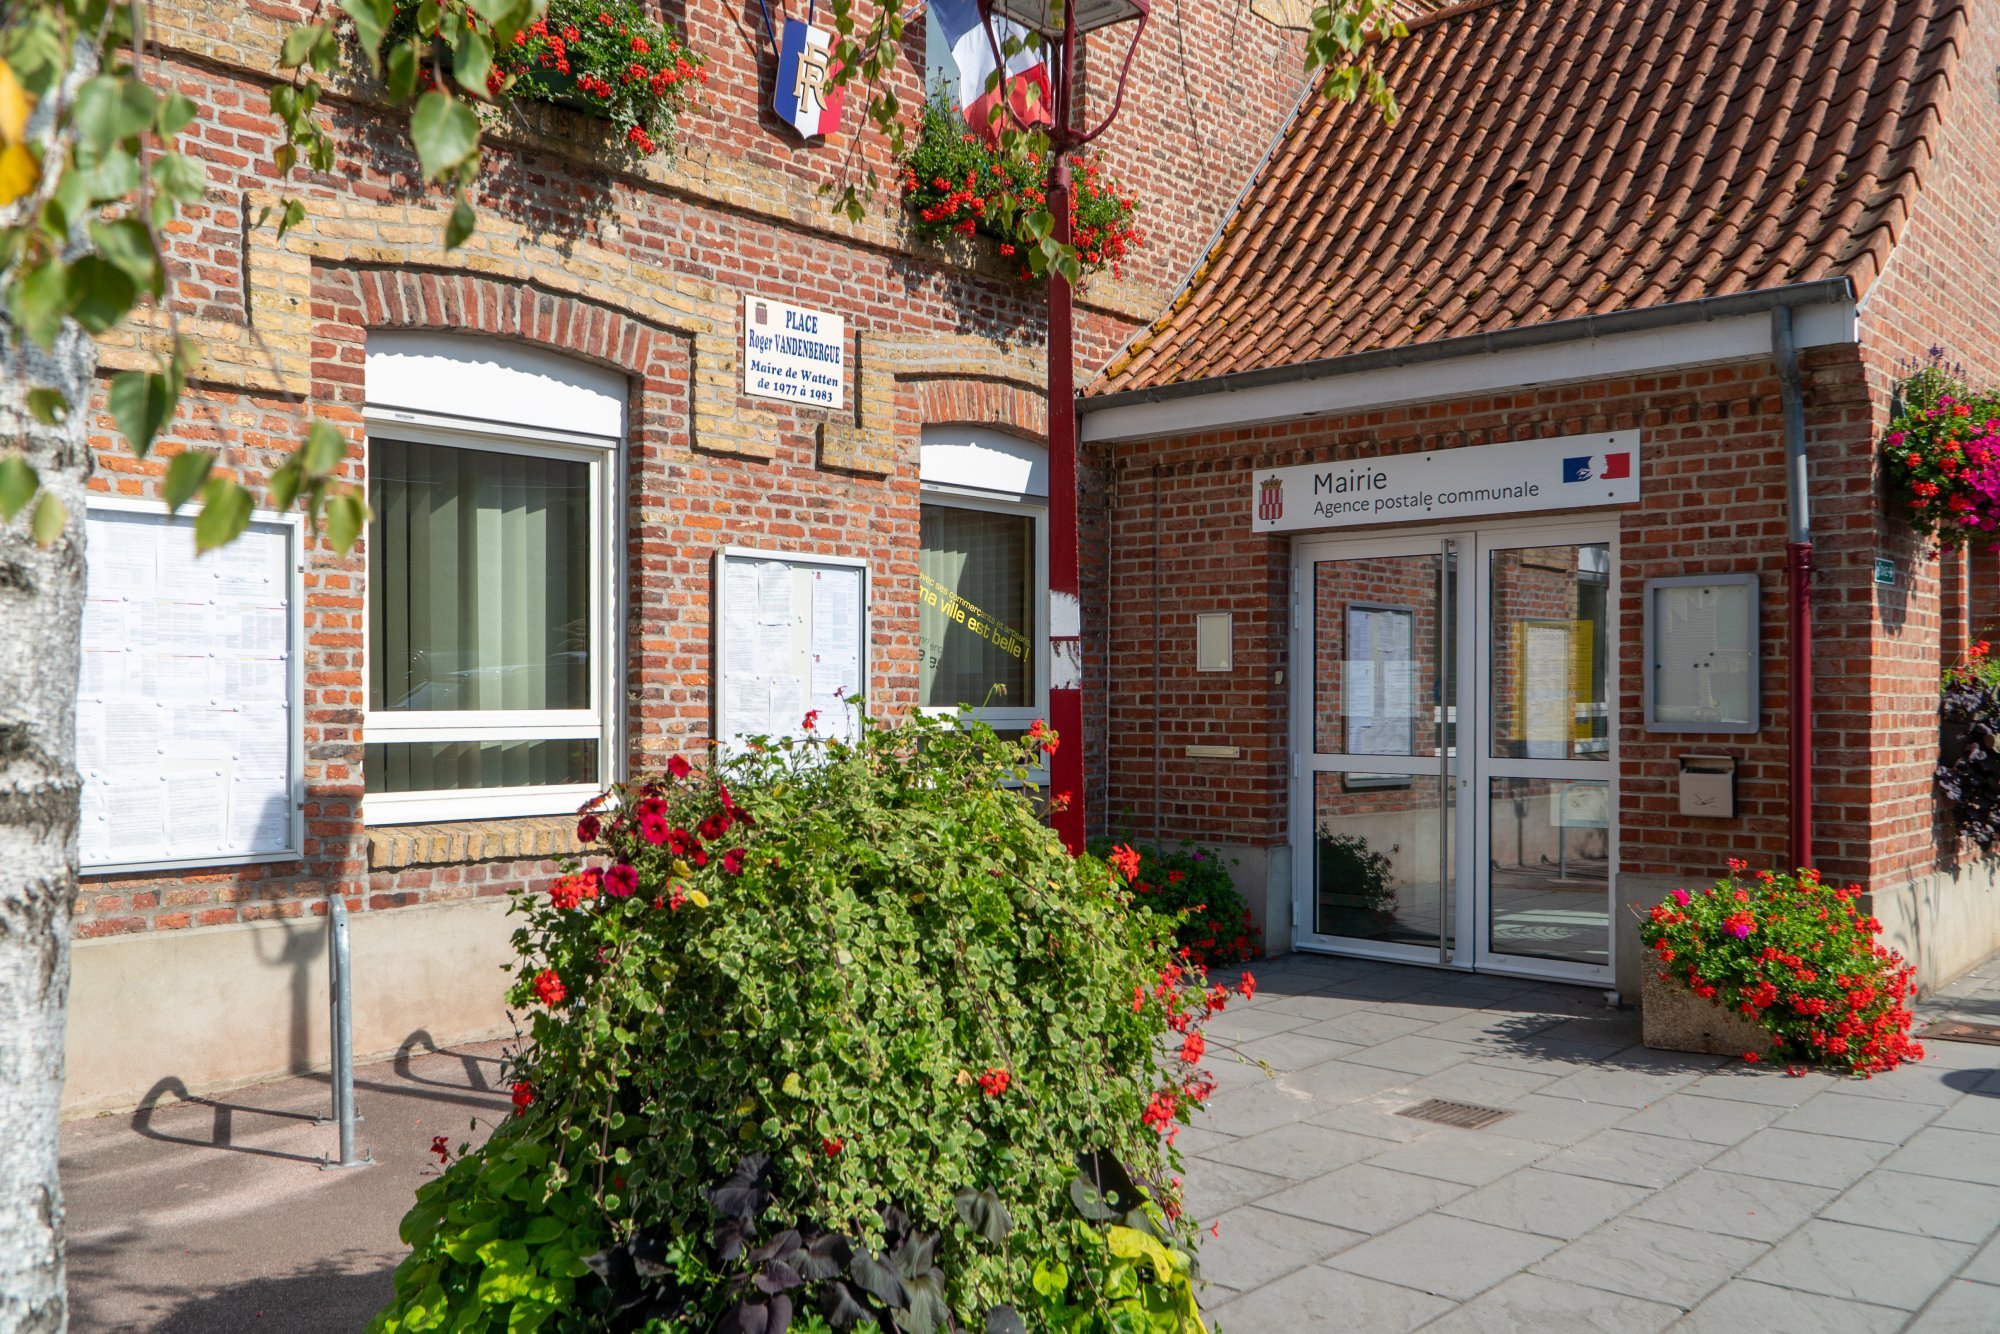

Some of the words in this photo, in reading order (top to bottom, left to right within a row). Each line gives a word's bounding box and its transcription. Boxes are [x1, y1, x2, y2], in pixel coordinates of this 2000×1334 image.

[786, 310, 818, 335] PLACE
[749, 329, 773, 354] Roger
[775, 334, 840, 364] VANDENBERGUE
[750, 360, 783, 376] Maire
[785, 367, 798, 379] de
[801, 369, 838, 387] Watten
[757, 378, 770, 390] de
[773, 382, 798, 396] 1977
[800, 385, 806, 396] à
[810, 389, 833, 403] 1983
[1314, 466, 1387, 496] Mairie
[1313, 499, 1370, 519] Agence
[1374, 491, 1433, 514] postale
[1437, 481, 1540, 505] communale
[935, 582, 949, 596] ses
[940, 598, 966, 624] ville
[967, 617, 991, 639] est
[991, 627, 1022, 659] belle
